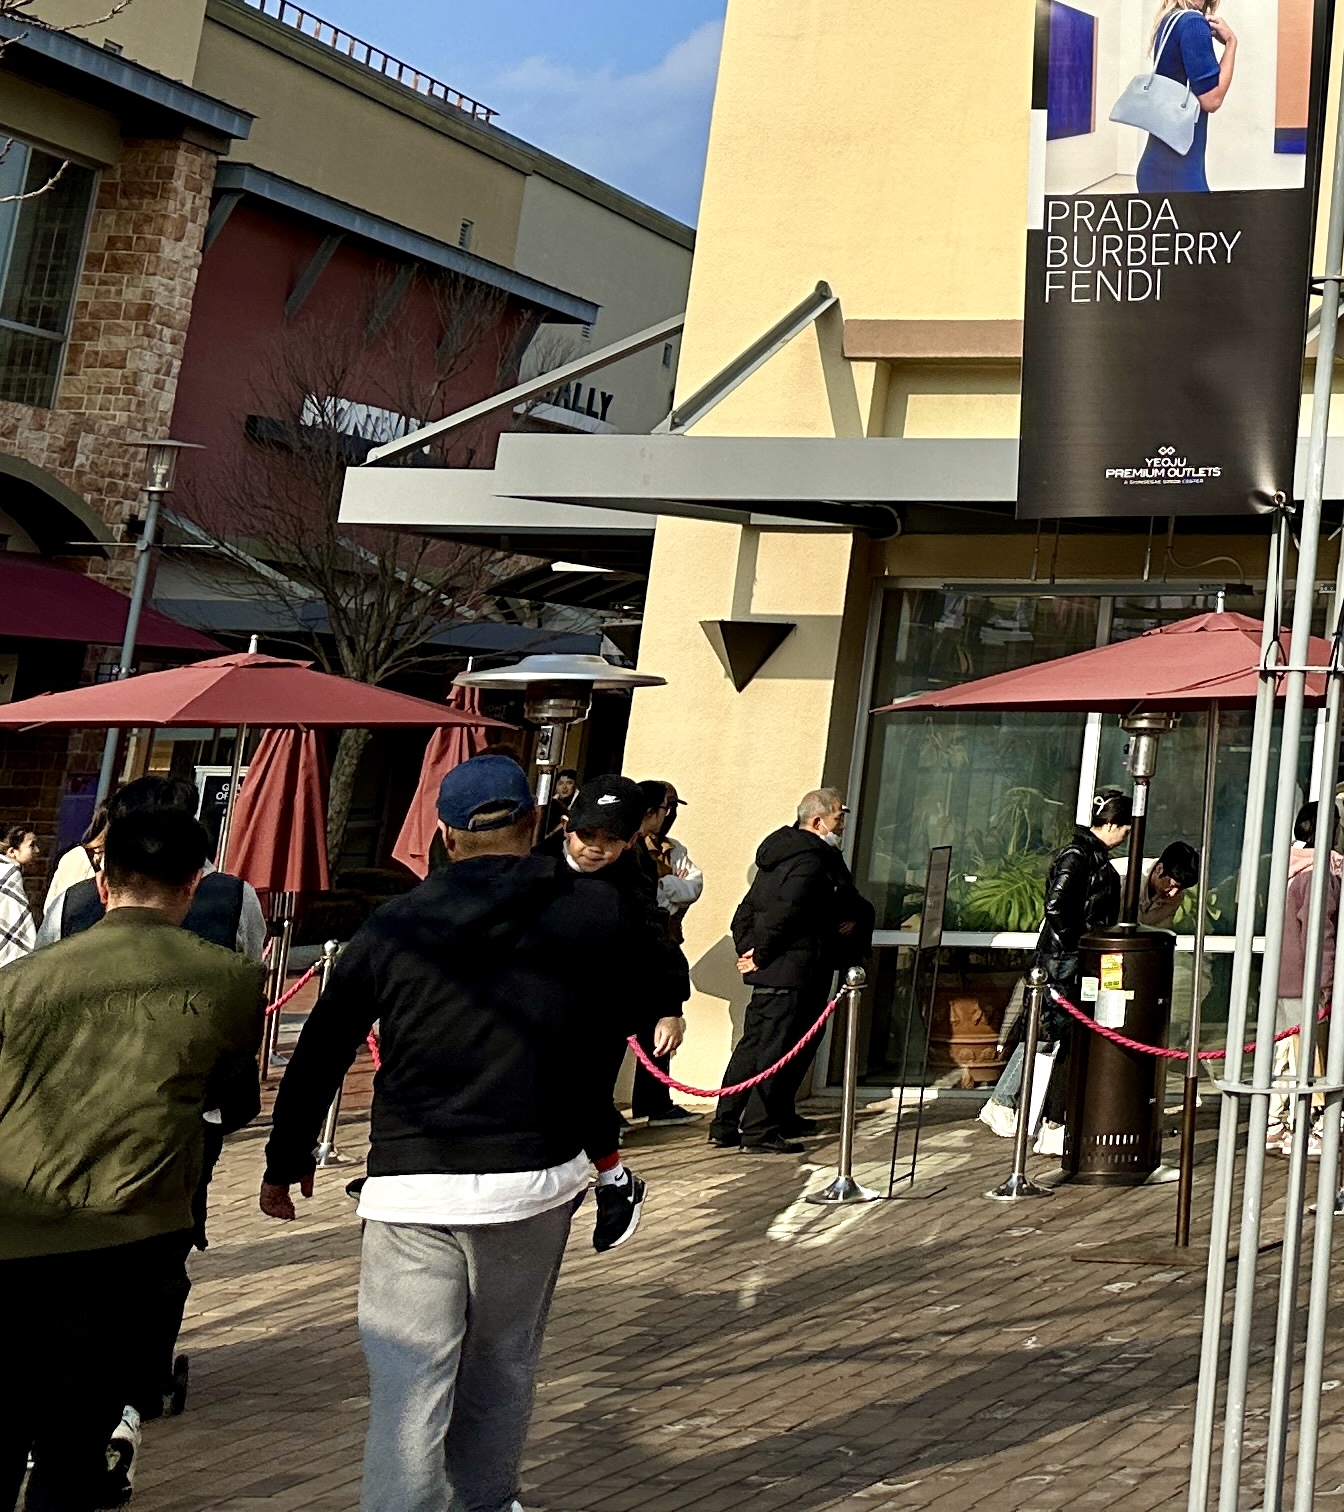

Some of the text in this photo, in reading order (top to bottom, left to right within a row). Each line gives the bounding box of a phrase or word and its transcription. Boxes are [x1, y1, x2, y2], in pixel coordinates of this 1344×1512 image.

[1047, 198, 1180, 232] PRADA
[1046, 230, 1242, 268] BURBERRY
[1045, 268, 1161, 303] FENDI
[1105, 466, 1222, 479] PREMIUM OUTLETS
[1145, 457, 1187, 468] YEOJU
